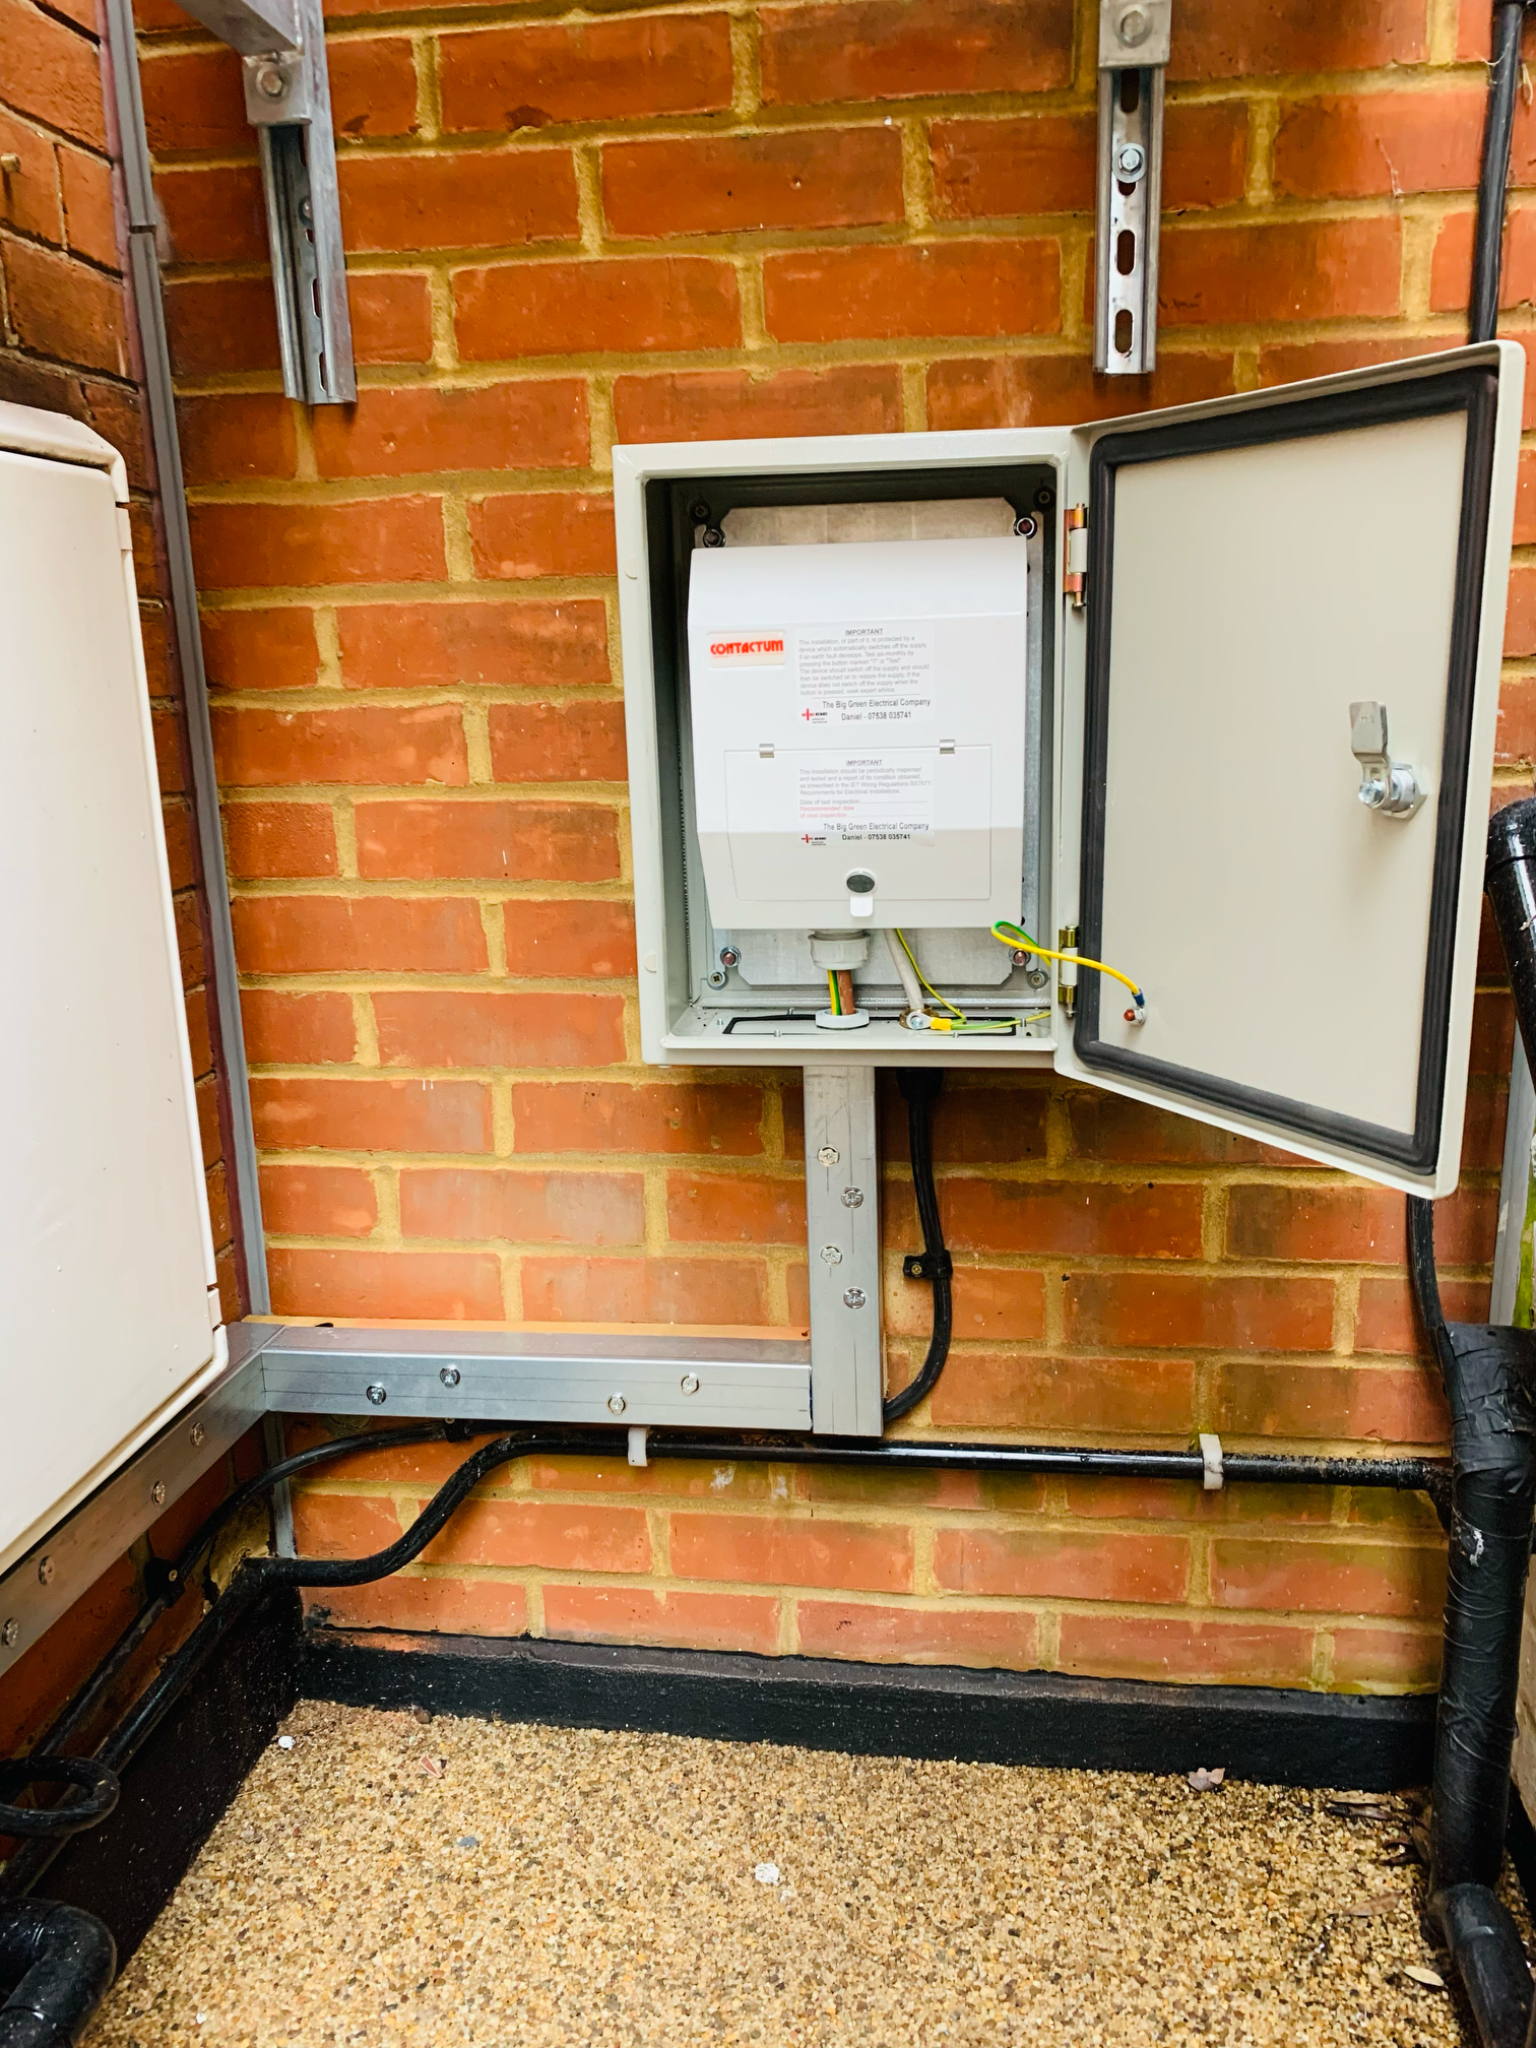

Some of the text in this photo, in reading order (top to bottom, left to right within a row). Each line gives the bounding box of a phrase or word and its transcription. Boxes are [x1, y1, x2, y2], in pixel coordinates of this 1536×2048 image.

[710, 639, 784, 655] CONTACTUM
[836, 701, 846, 709] Big
[900, 698, 931, 706] Company
[836, 823, 846, 832] Big
[899, 822, 929, 830] Company
